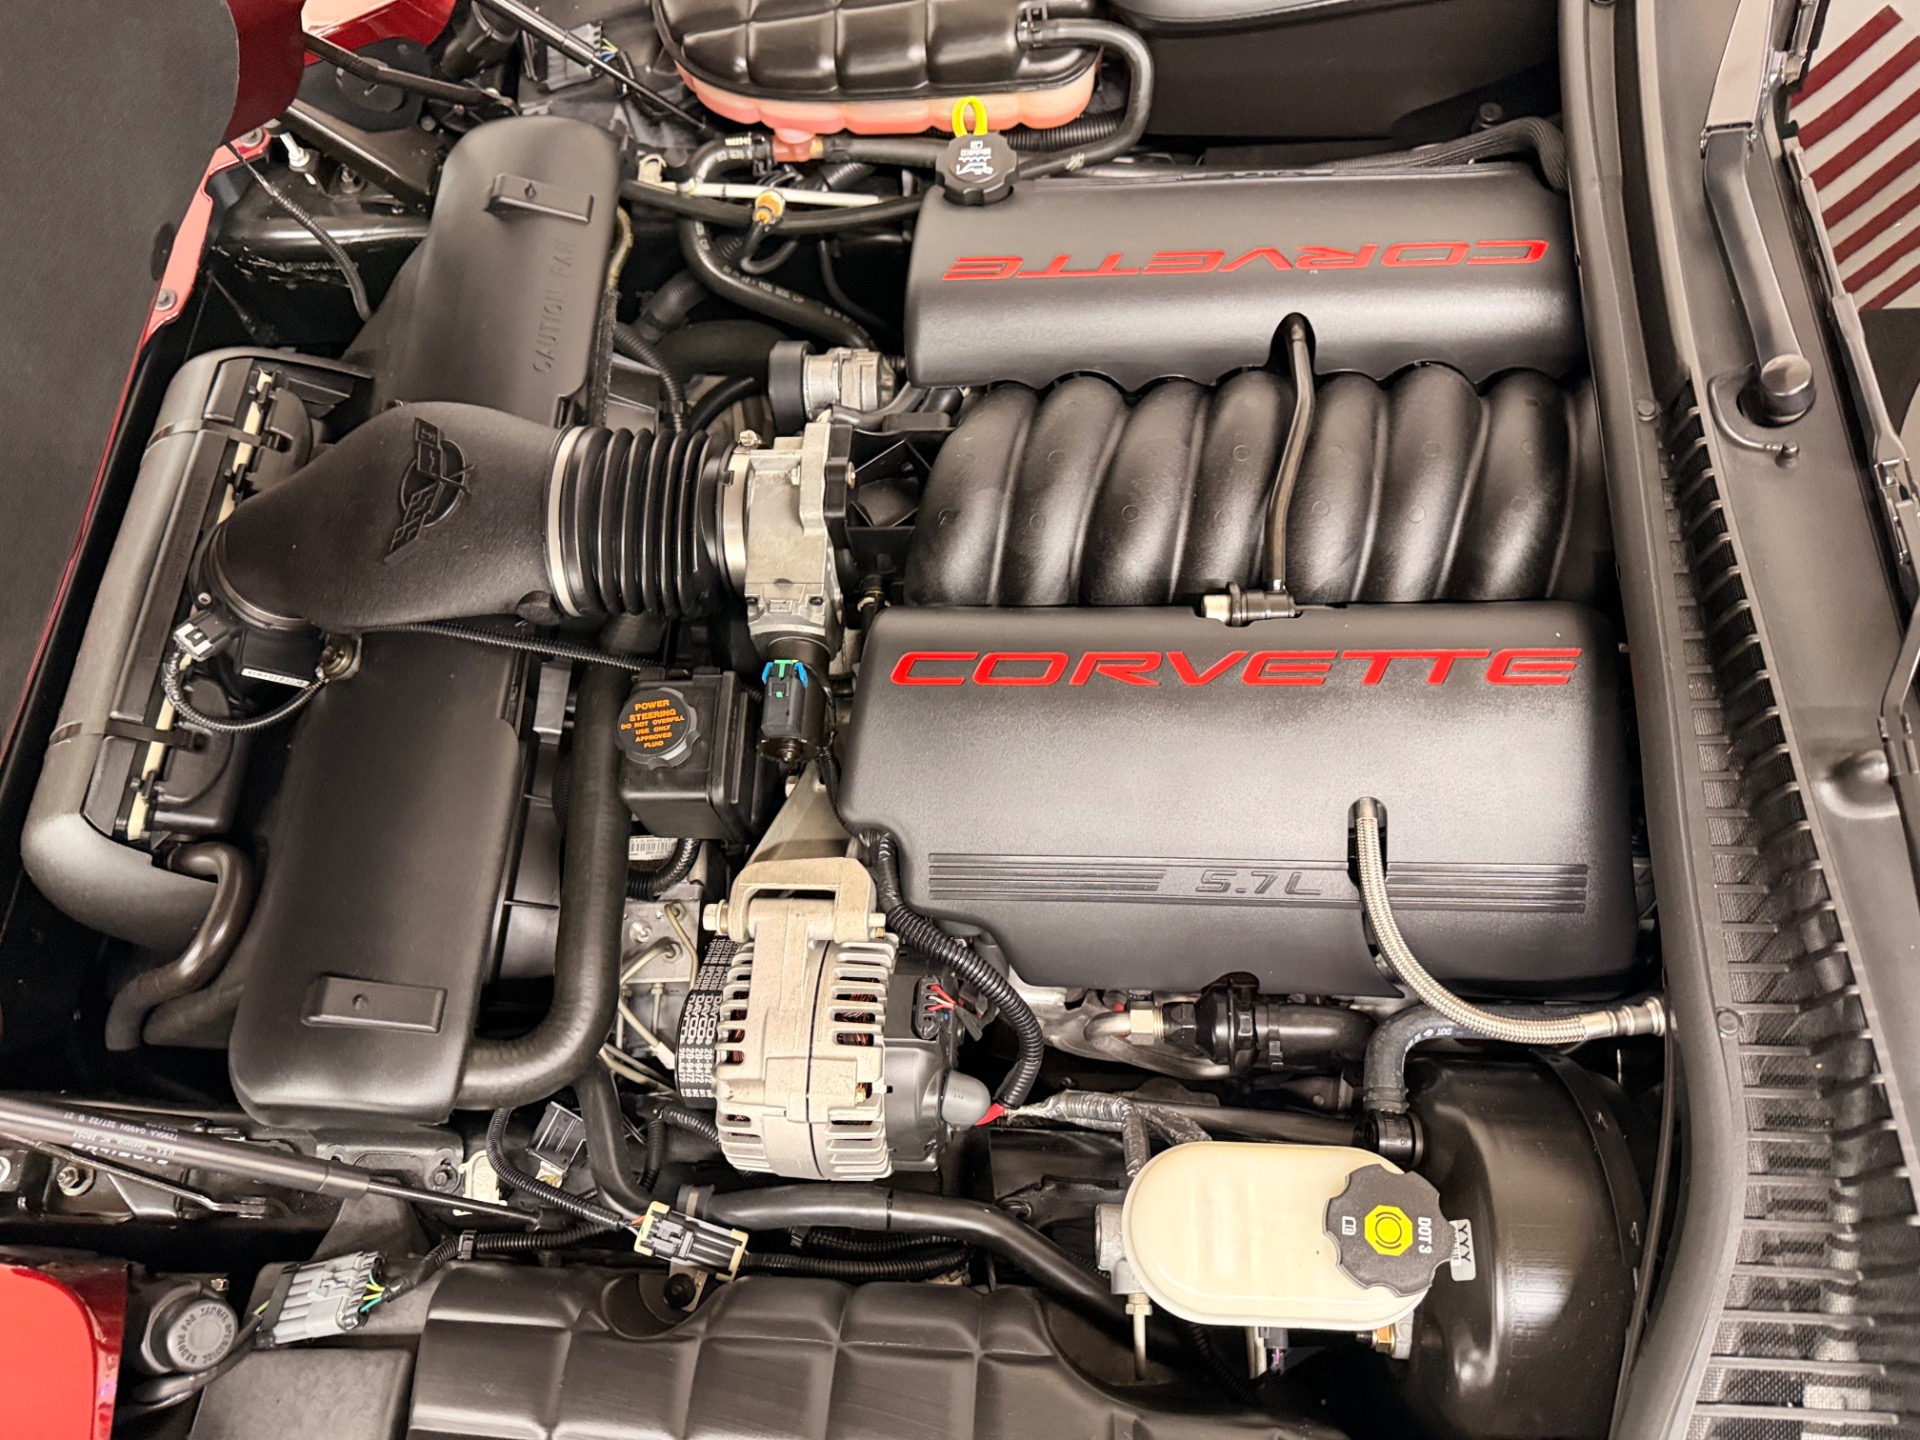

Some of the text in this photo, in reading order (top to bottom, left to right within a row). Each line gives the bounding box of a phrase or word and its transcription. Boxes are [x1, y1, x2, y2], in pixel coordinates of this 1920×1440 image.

[942, 239, 1550, 281] CORVETTE
[532, 239, 576, 373] CAUTION FAN
[890, 648, 1582, 686] CORVETTE
[628, 708, 677, 722] STEERING
[634, 699, 670, 711] POWER
[634, 720, 649, 728] NOT
[651, 715, 685, 725] OVERFILL
[653, 724, 671, 732] ONLY
[635, 731, 673, 743] APPROVED
[643, 740, 664, 748] FLUID
[1195, 869, 1322, 895] 5.7L
[1435, 1027, 1453, 1036] DOT
[685, 1048, 695, 1083] 20-9472
[694, 1048, 704, 1083] 20-9472
[71, 1142, 169, 1165] STABILUS
[1418, 1216, 1432, 1254] DOT 3
[1458, 1223, 1471, 1263] YYY
[181, 1314, 196, 1331] FOR
